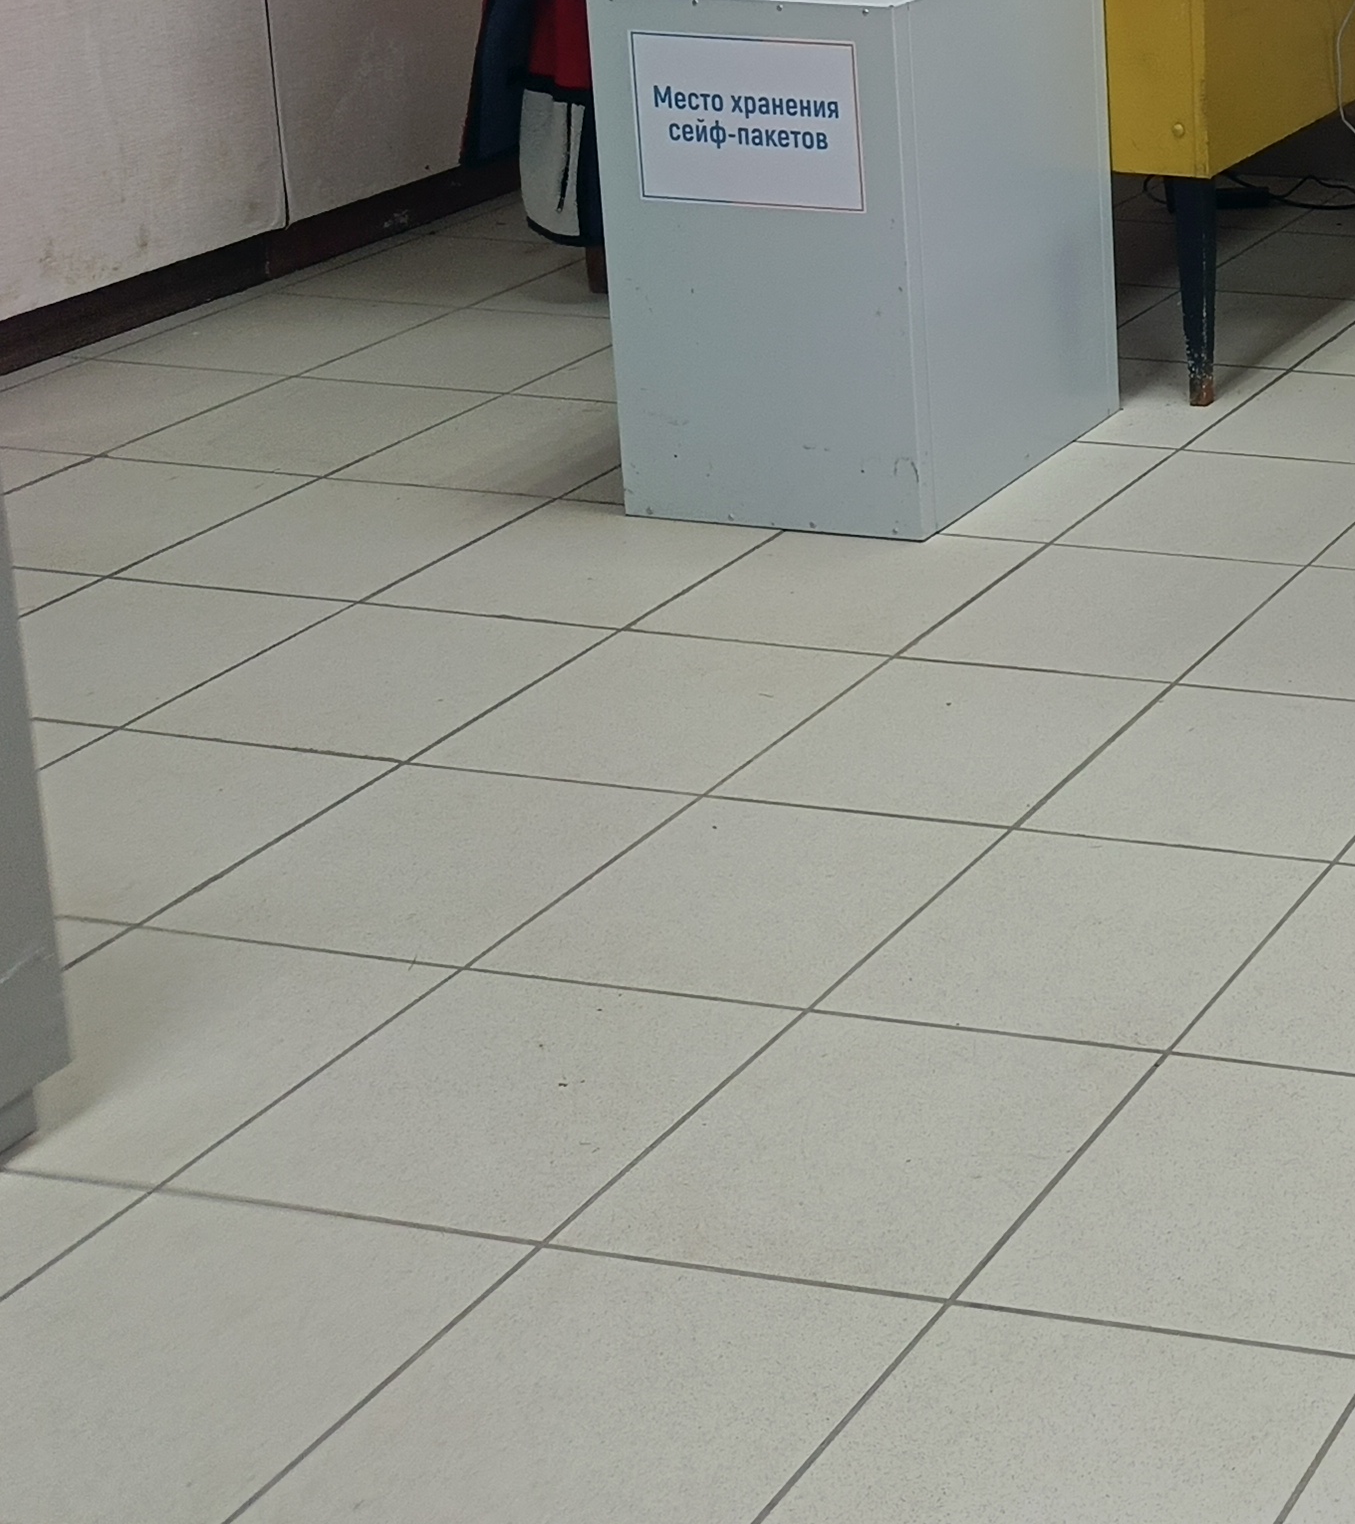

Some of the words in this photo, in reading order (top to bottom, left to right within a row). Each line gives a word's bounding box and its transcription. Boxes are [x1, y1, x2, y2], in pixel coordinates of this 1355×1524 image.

[653, 84, 724, 113] Место
[731, 93, 840, 120] хранения
[668, 118, 829, 150] сейф-пакетов
